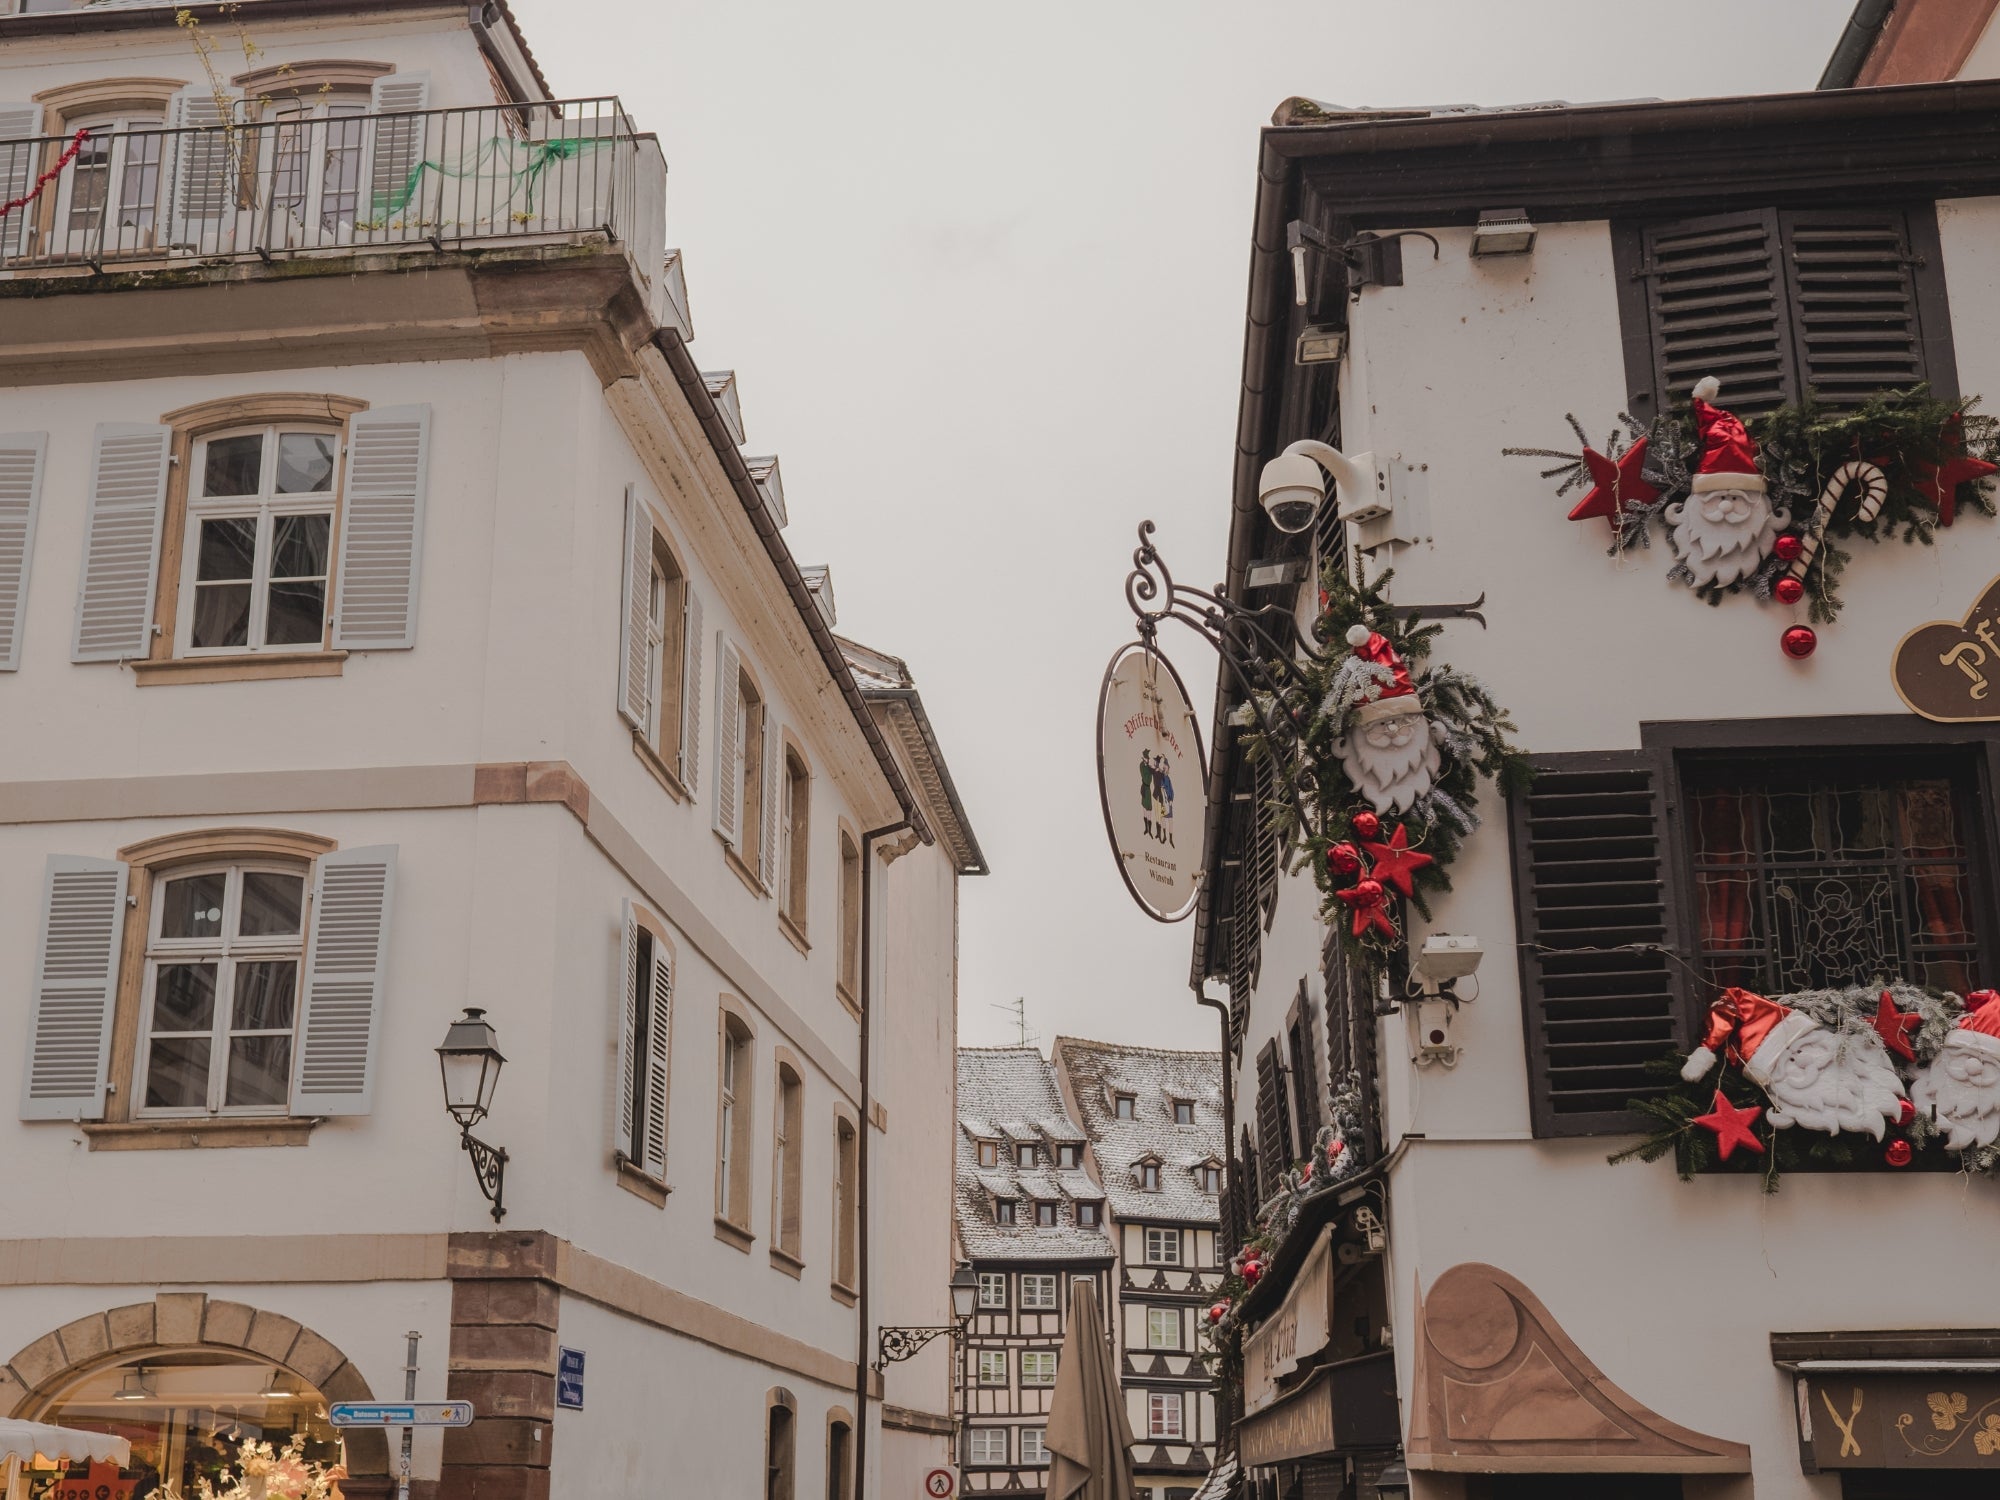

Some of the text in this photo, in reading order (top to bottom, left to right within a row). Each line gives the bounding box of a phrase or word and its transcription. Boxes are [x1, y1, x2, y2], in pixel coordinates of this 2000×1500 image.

[1939, 618, 2000, 700] Pf
[1124, 712, 1184, 760] Pfifferbder
[1145, 851, 1177, 872] Restaurant
[1149, 869, 1174, 887] Winstub
